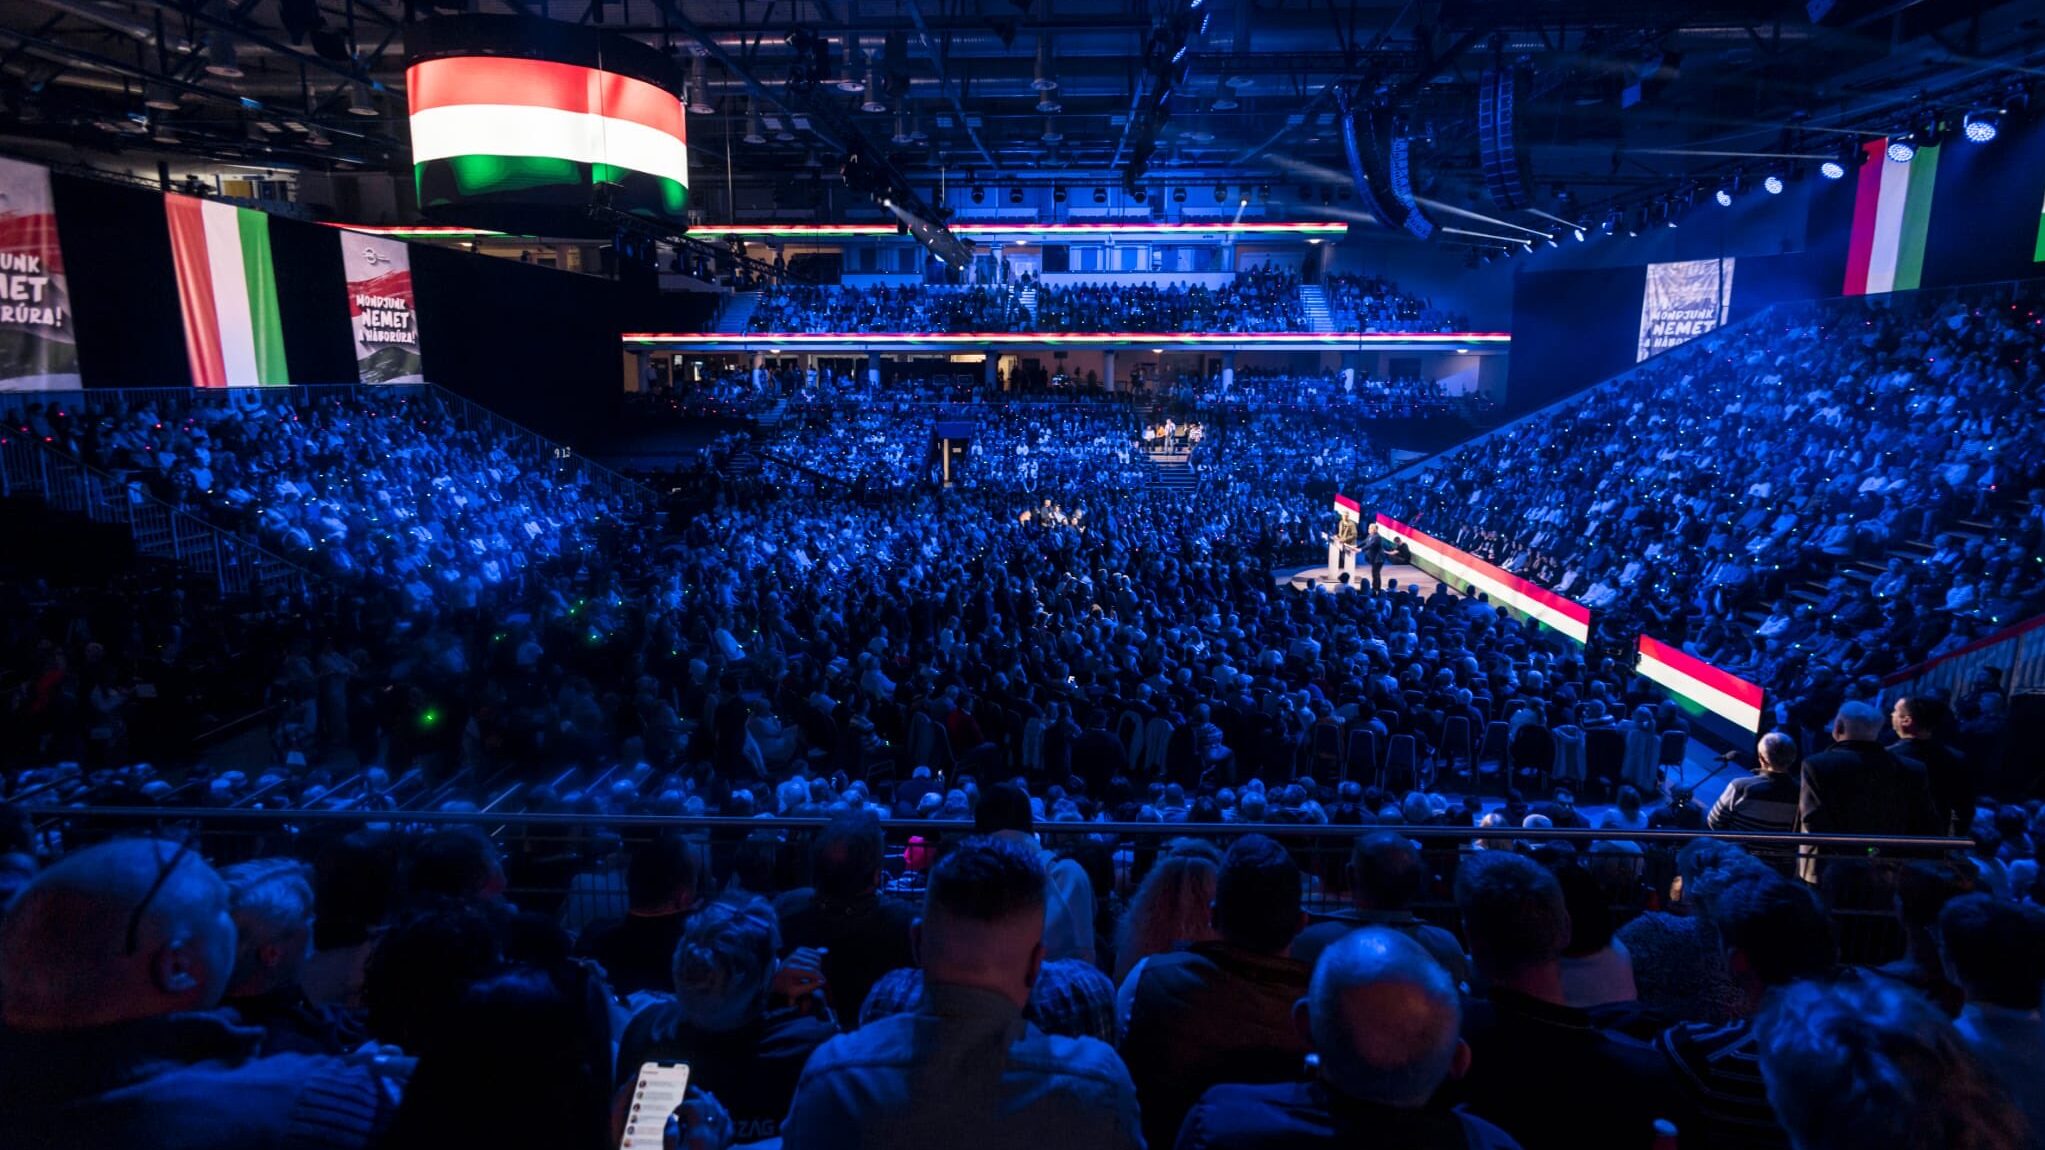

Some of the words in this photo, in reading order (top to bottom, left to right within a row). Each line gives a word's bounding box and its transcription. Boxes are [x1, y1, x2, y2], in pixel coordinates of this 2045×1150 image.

[356, 294, 406, 309] MONDJUNK
[361, 308, 410, 329] NEMET
[1652, 320, 1717, 335] NEMET
